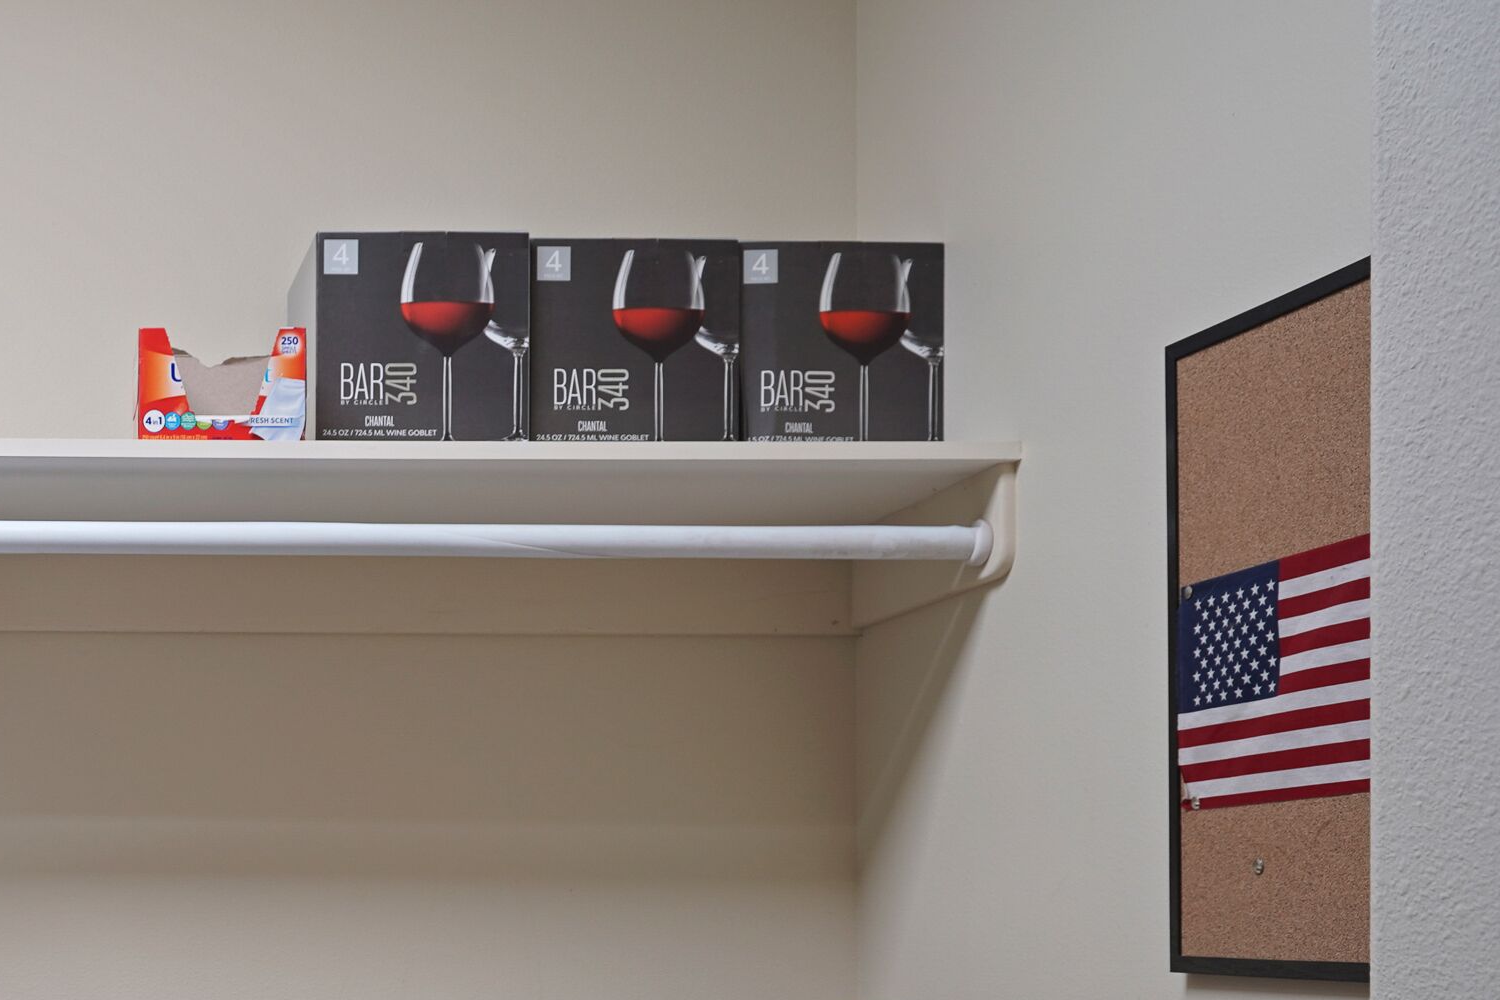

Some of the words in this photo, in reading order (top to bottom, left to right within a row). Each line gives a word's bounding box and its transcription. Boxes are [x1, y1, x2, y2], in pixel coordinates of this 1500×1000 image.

[332, 242, 349, 266] 4
[545, 249, 563, 272] 4
[752, 252, 770, 275] 4
[281, 336, 299, 345] 250
[340, 362, 384, 401] BAR
[385, 362, 418, 406] 340
[553, 368, 596, 405] BAR
[597, 368, 630, 411] 340
[760, 370, 803, 407] BAR
[804, 370, 836, 413] 340
[364, 415, 395, 427] CHANTAL
[577, 420, 608, 432] CHANTAL
[784, 422, 814, 434] CHANTAL
[338, 429, 349, 437] OZ
[355, 429, 373, 437] 724.5
